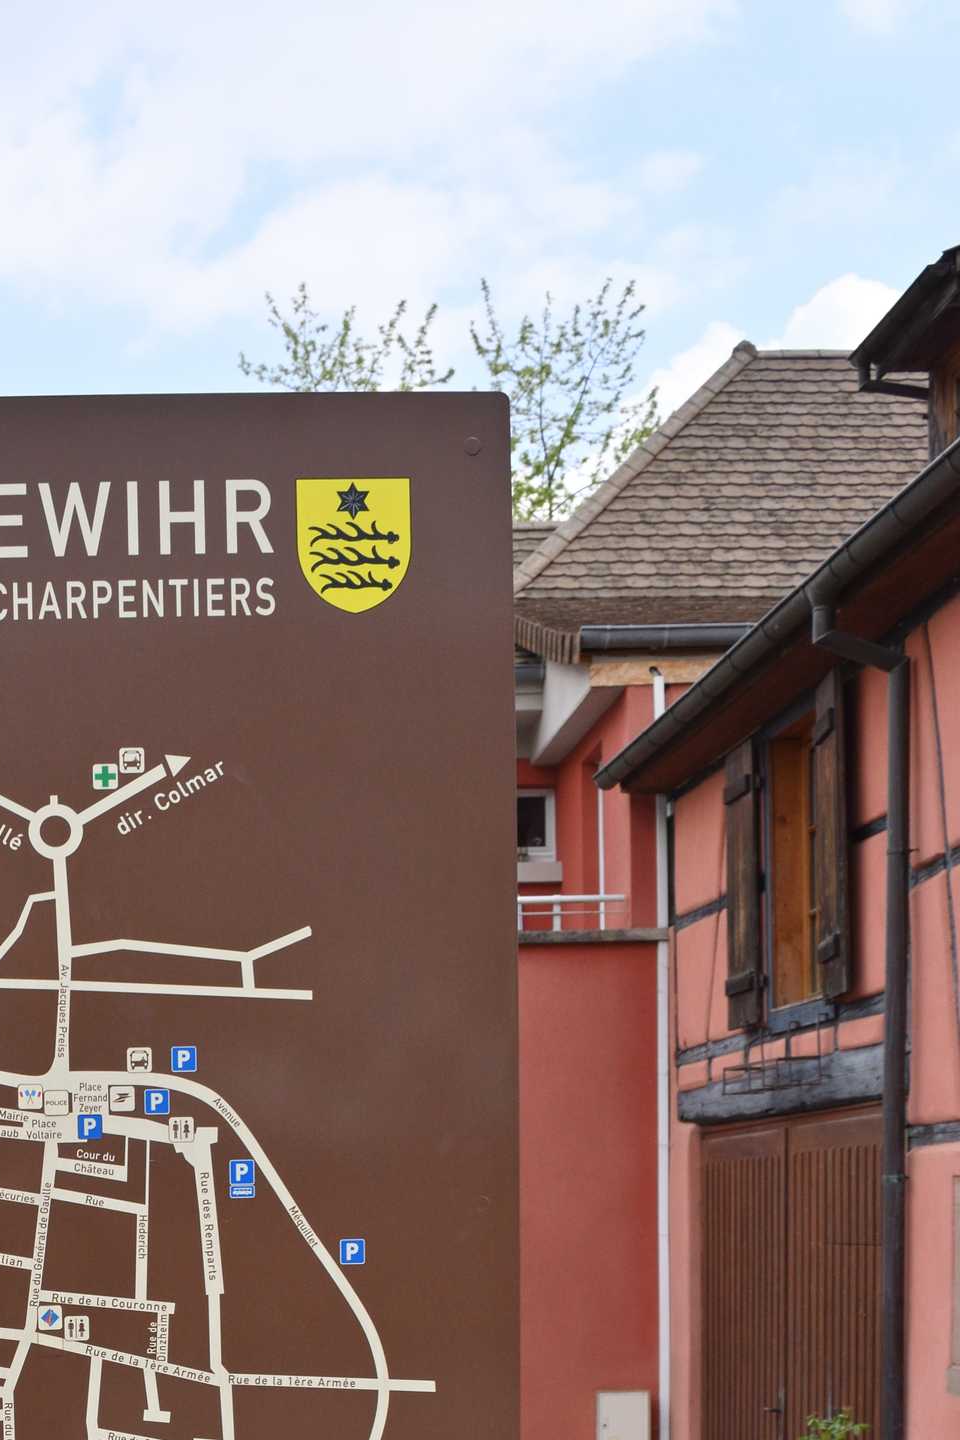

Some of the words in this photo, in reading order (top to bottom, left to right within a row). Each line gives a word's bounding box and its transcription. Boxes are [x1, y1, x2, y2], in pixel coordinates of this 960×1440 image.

[117, 811, 152, 835] dir.
[155, 761, 225, 811] Colmar
[59, 985, 69, 1024] Jacques
[58, 1025, 67, 1057] Preiss
[80, 1083, 101, 1092] Place
[74, 1093, 107, 1102] Fernand
[0, 1110, 29, 1122] Mairie
[79, 1104, 101, 1113] Zeyer
[32, 1119, 56, 1128] Place
[26, 1130, 62, 1140] Voltaire
[77, 1150, 100, 1160] Cour
[102, 1152, 115, 1162] du
[74, 1163, 114, 1176] Château
[213, 1097, 240, 1128] Avenue
[289, 1206, 318, 1248] Méquillet
[200, 1172, 209, 1194] Rue
[0, 1189, 35, 1203] écuries
[40, 1182, 52, 1214] Gaulle
[202, 1199, 211, 1219] des
[37, 1217, 48, 1229] de
[86, 1196, 104, 1207] Rue
[139, 1215, 147, 1259] Hederich
[33, 1233, 46, 1269] Général
[204, 1224, 217, 1281] Remparts
[32, 1273, 41, 1286] du
[30, 1291, 39, 1307] Rue
[52, 1294, 73, 1304] Rue
[79, 1296, 91, 1305] de
[97, 1297, 106, 1306] la
[112, 1299, 167, 1312] Couronne
[148, 1322, 157, 1332] de
[148, 1335, 156, 1354] Rue
[86, 1346, 106, 1358] Rue
[111, 1351, 124, 1362] de
[129, 1355, 139, 1365] la
[145, 1359, 168, 1373] 1ère
[173, 1369, 210, 1383] Armée
[228, 1375, 249, 1384] Rue
[255, 1376, 267, 1385] de
[273, 1377, 282, 1385] la
[289, 1377, 313, 1387] 1ère
[318, 1378, 355, 1388] Armée
[4, 1402, 12, 1421] Rue
[5, 1424, 12, 1435] du
